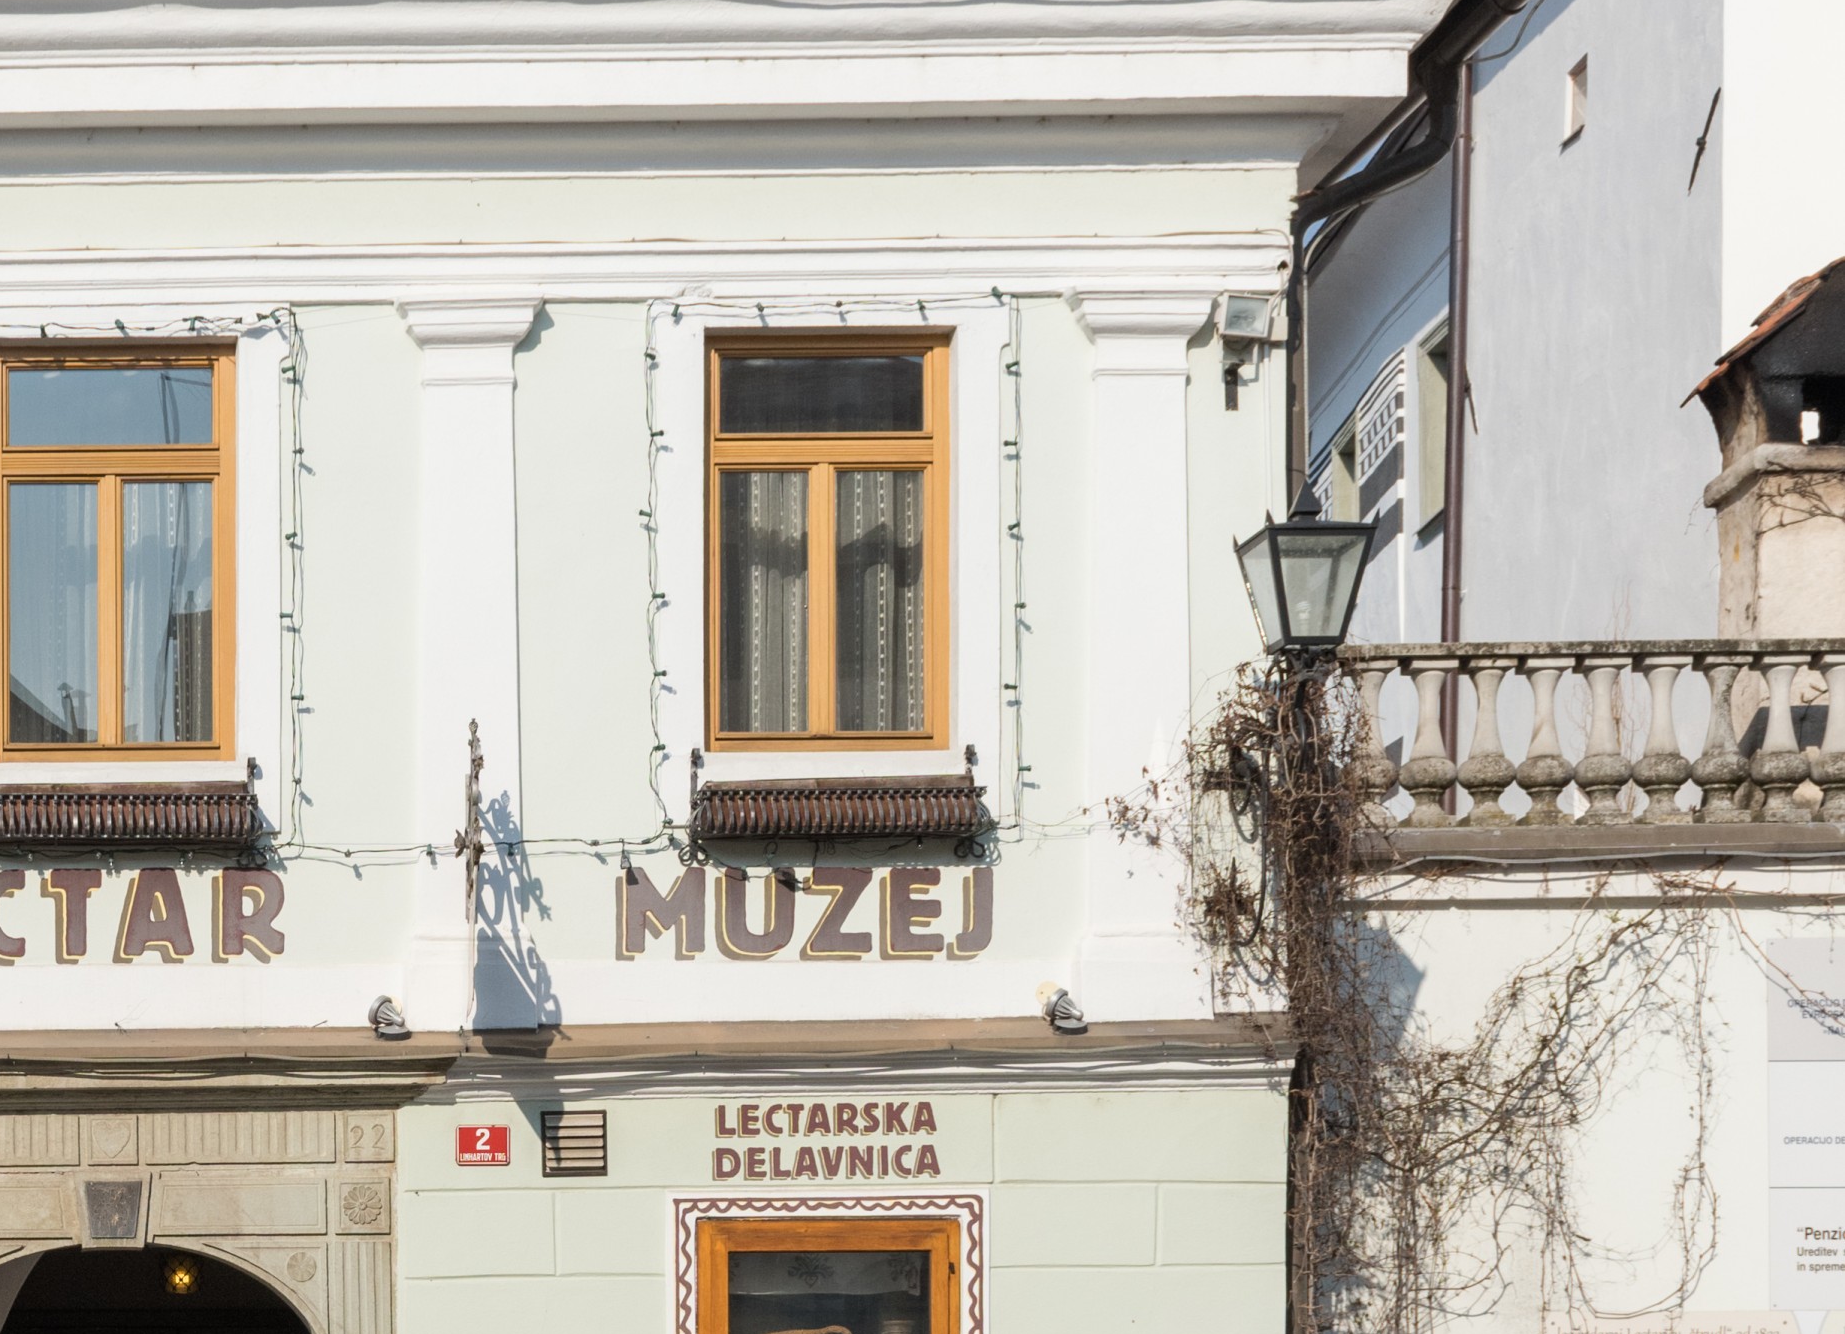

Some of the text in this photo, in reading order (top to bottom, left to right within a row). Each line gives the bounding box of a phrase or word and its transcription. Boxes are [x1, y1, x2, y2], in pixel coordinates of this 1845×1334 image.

[615, 866, 995, 961] MUZEJ
[715, 1101, 938, 1139] LECTARSKA
[349, 1123, 386, 1151] 22
[476, 1128, 491, 1150] 2
[1784, 1136, 1833, 1145] OPERACIJO
[459, 1152, 506, 1161] LINHARTOV TRG
[712, 1143, 942, 1181] DELAVNICA
[1797, 1227, 1845, 1240] “Penzi
[1797, 1247, 1838, 1257] Ureditev
[1797, 1262, 1806, 1272] in
